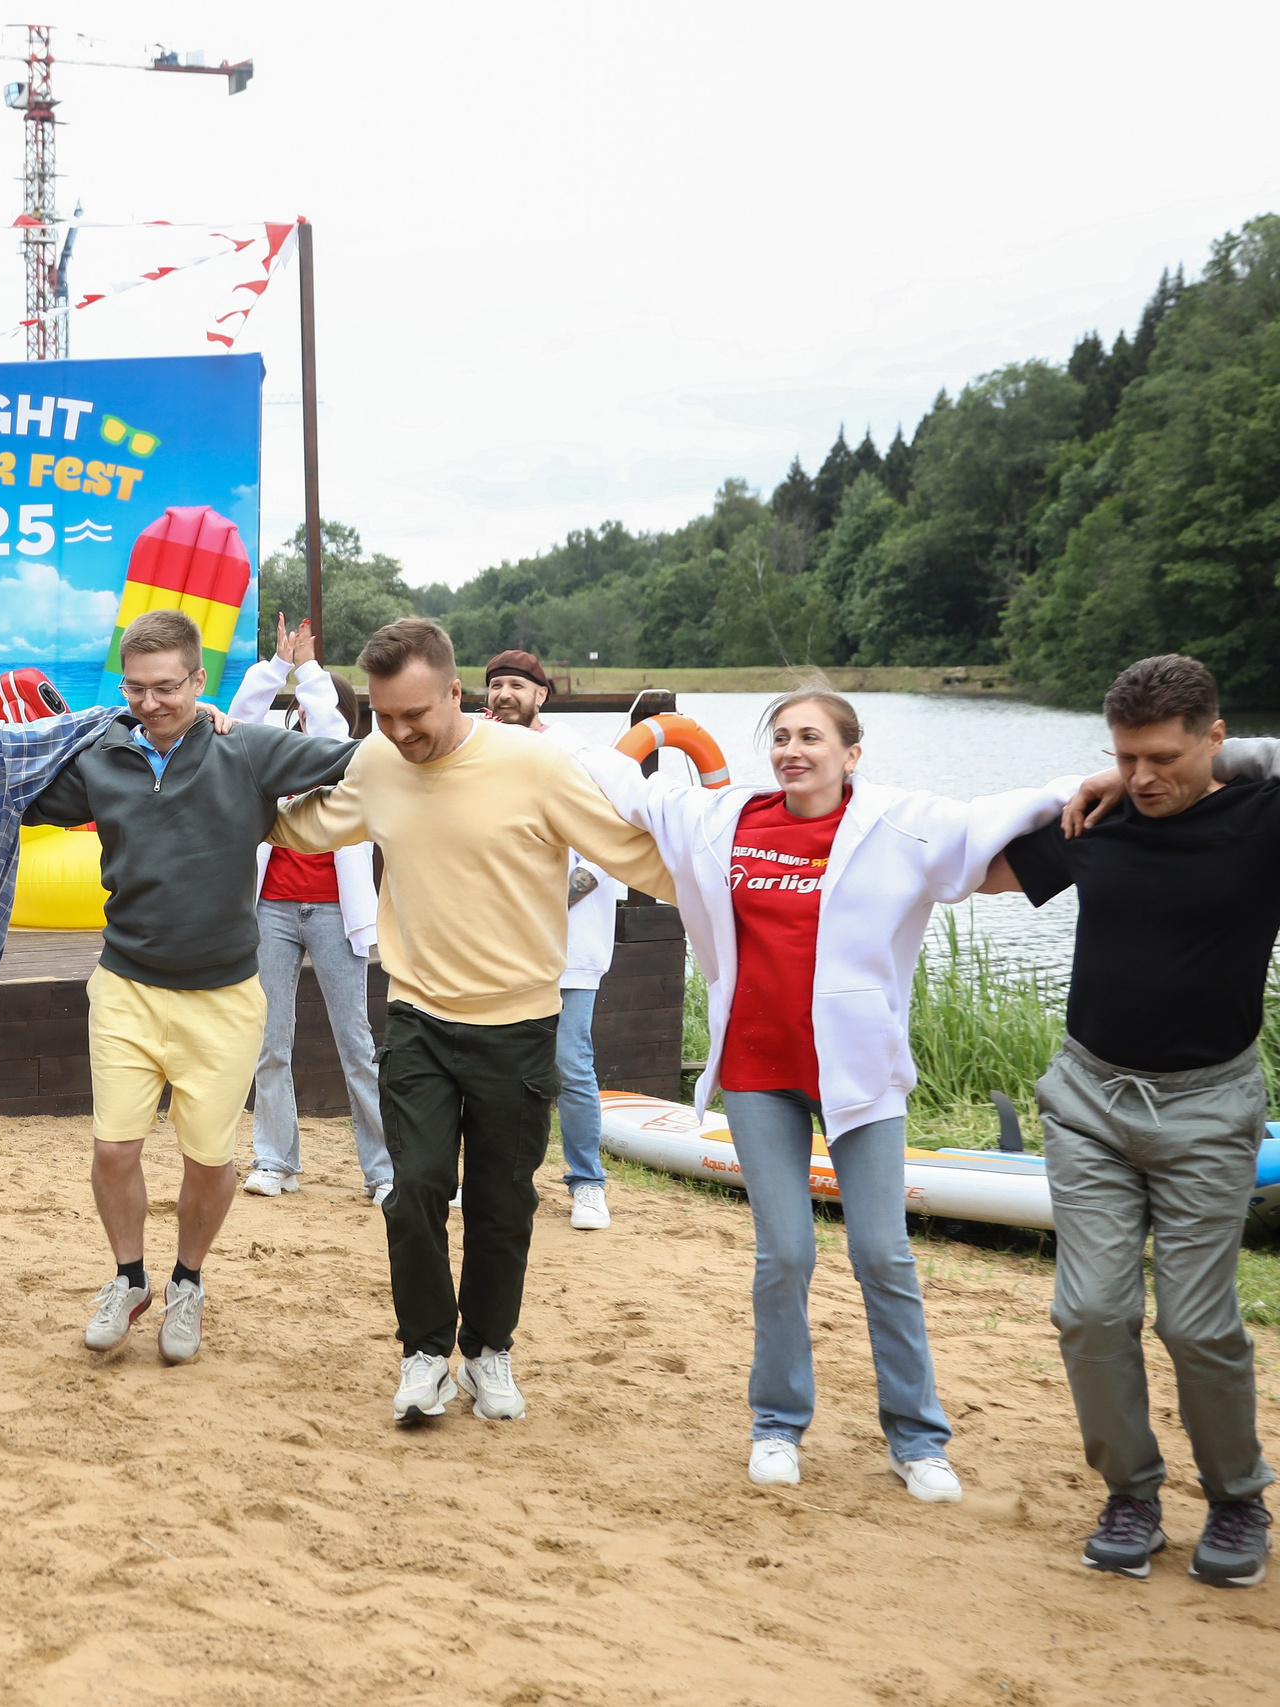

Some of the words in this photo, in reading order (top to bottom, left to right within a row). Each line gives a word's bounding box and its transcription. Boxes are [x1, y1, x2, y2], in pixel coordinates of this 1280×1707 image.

[732, 845, 777, 862] ДЕЛАЙ
[777, 853, 810, 867] МИР
[702, 1156, 726, 1172] Aqua
